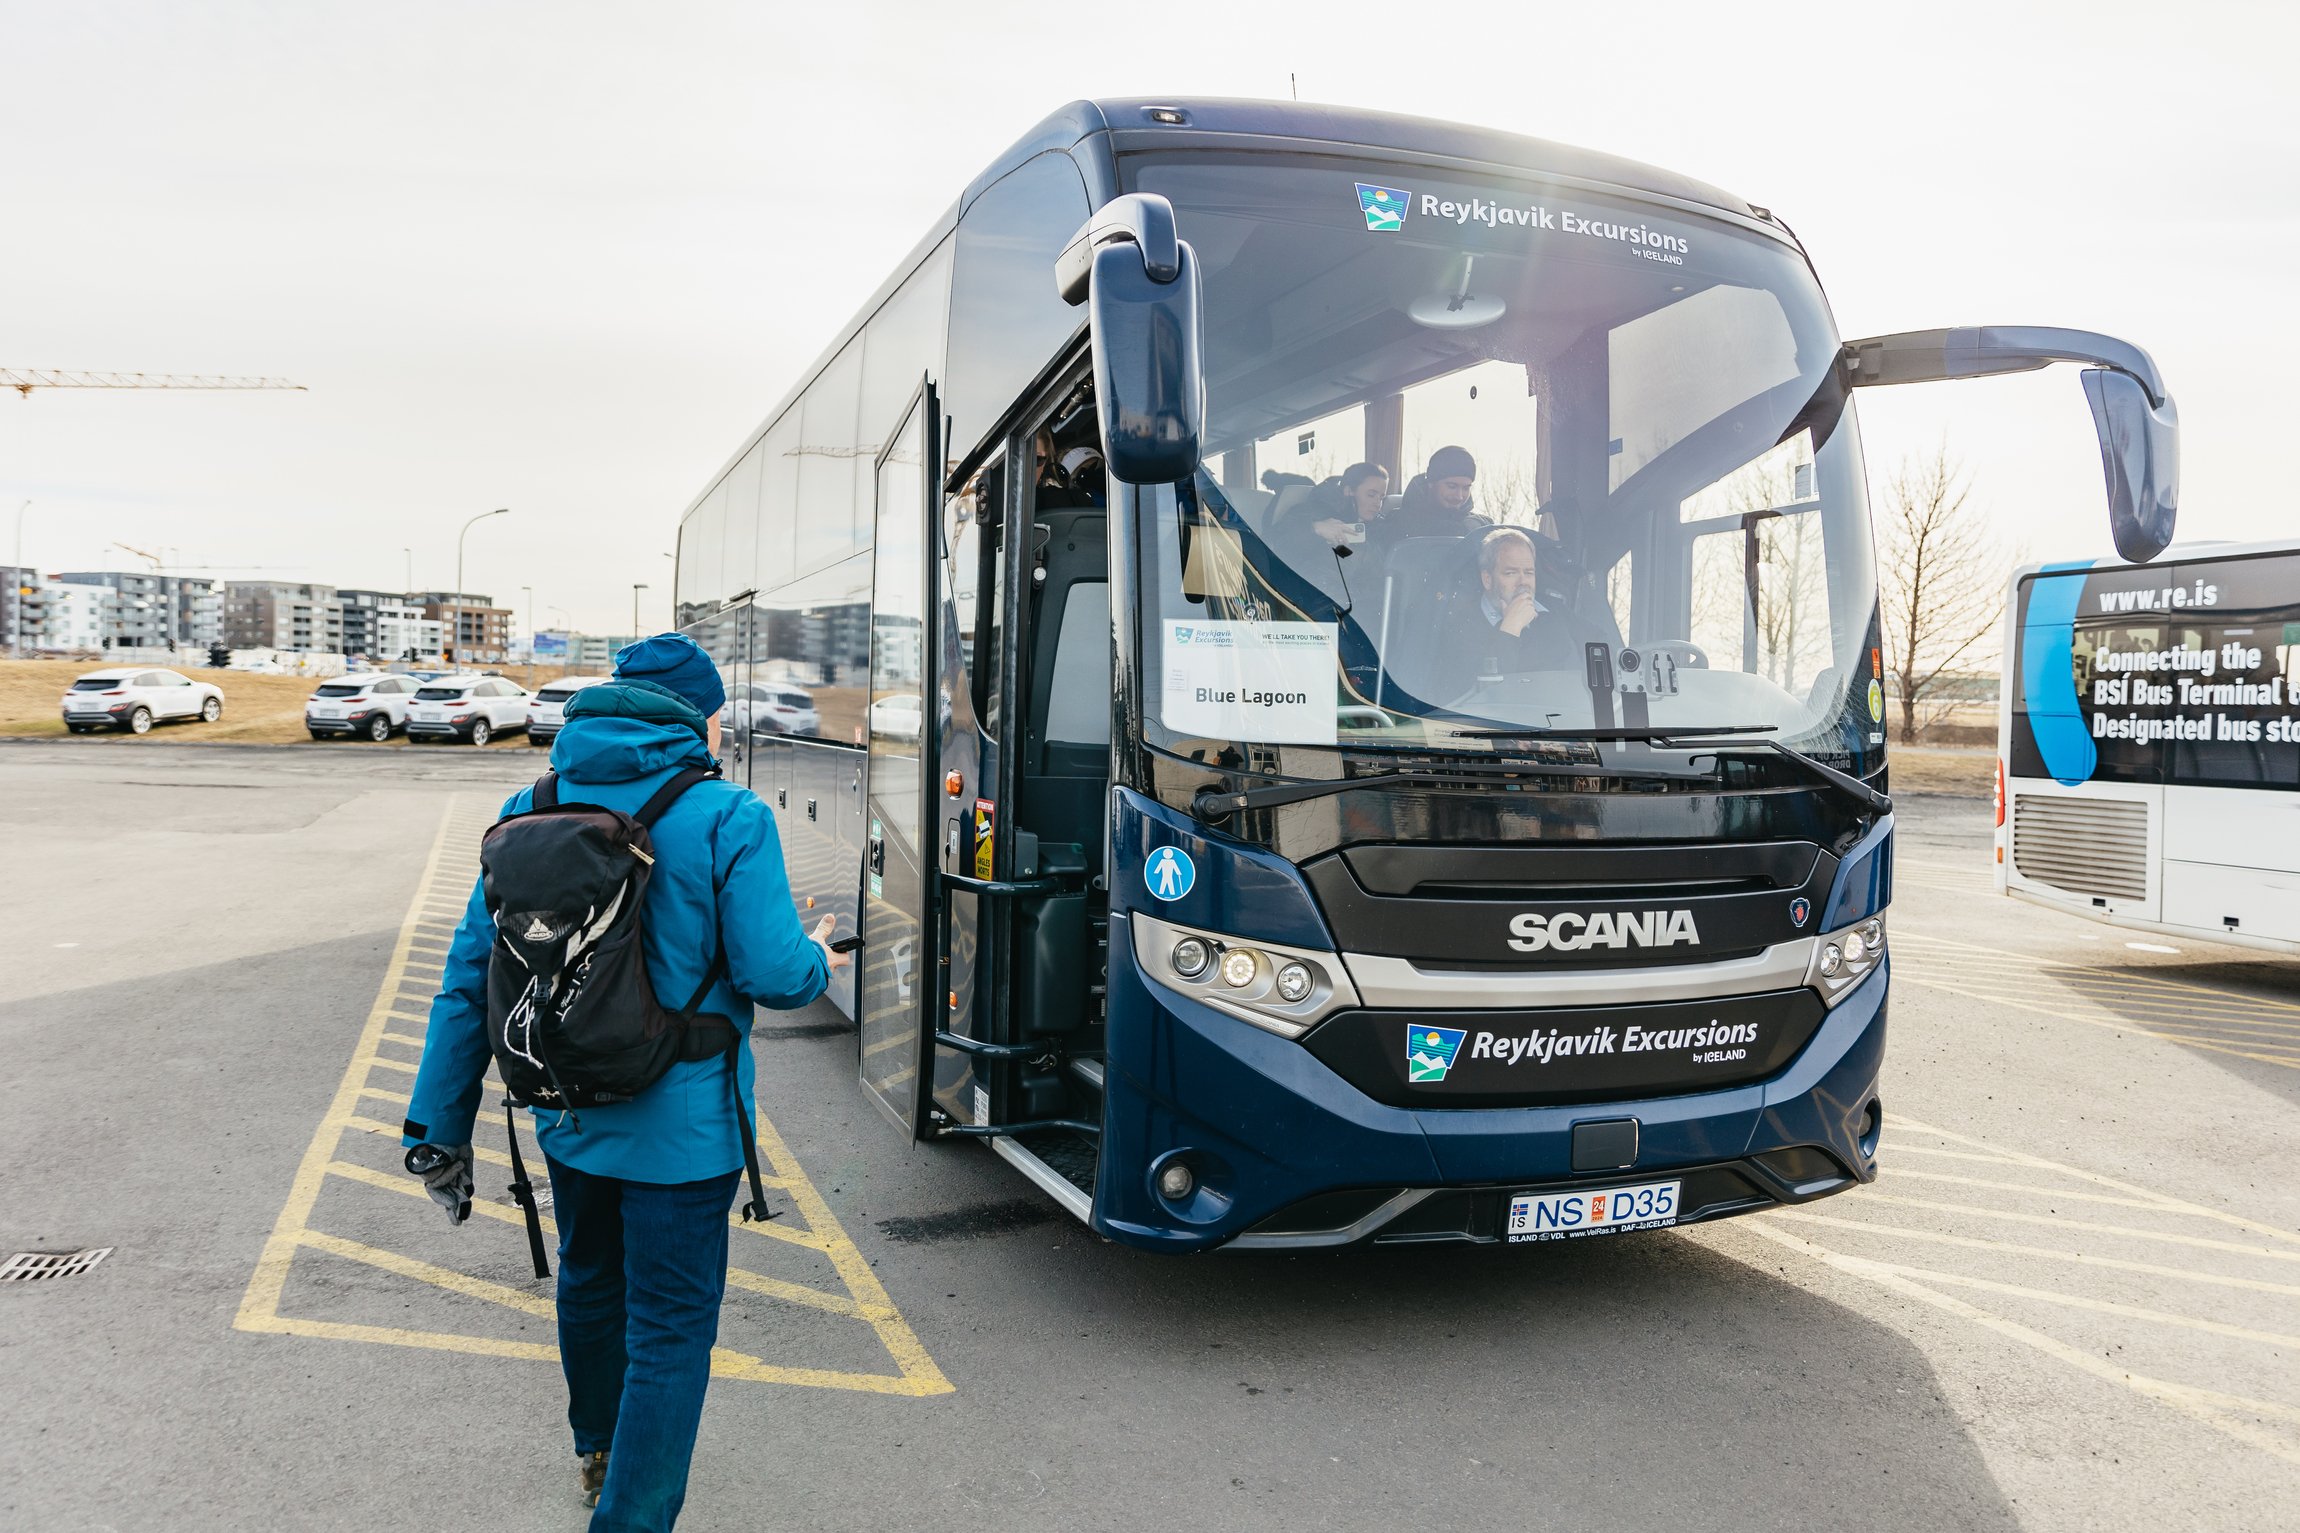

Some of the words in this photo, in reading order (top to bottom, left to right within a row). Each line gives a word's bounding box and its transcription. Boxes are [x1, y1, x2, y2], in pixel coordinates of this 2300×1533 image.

[1420, 193, 1555, 230] Reykjavik
[1561, 211, 1689, 254] Excursions
[1631, 247, 1641, 257] by
[1642, 249, 1683, 266] ICELAND
[2099, 578, 2218, 612] www.re.is
[1195, 636, 1234, 644] Excursions
[1196, 629, 1233, 638] Reykjavik
[2095, 643, 2217, 677] Connecting
[2221, 641, 2262, 670] the
[1196, 687, 1236, 703] Blue
[1242, 688, 1306, 707] Lagoon
[2094, 672, 2131, 706] BSÍ
[2132, 678, 2173, 706] Bus
[2177, 676, 2283, 706] Terminal
[2287, 679, 2300, 706] t
[2092, 712, 2213, 746] Designated
[2216, 713, 2262, 743] bus
[1506, 909, 1701, 952] SCANIA
[1470, 1026, 1616, 1066] Reykjavik
[1622, 1019, 1759, 1053] Excursions
[1692, 1053, 1703, 1063] by
[1704, 1048, 1747, 1063] ICELAND
[1535, 1197, 1584, 1229] NS
[1611, 1186, 1674, 1221] D35
[1593, 1200, 1604, 1212] 24
[1508, 1234, 1538, 1243] ISLAND
[1550, 1232, 1566, 1240] VDL
[1620, 1223, 1636, 1232] DAF
[1646, 1218, 1677, 1229] ICELAND
[1511, 1216, 1526, 1228] IS
